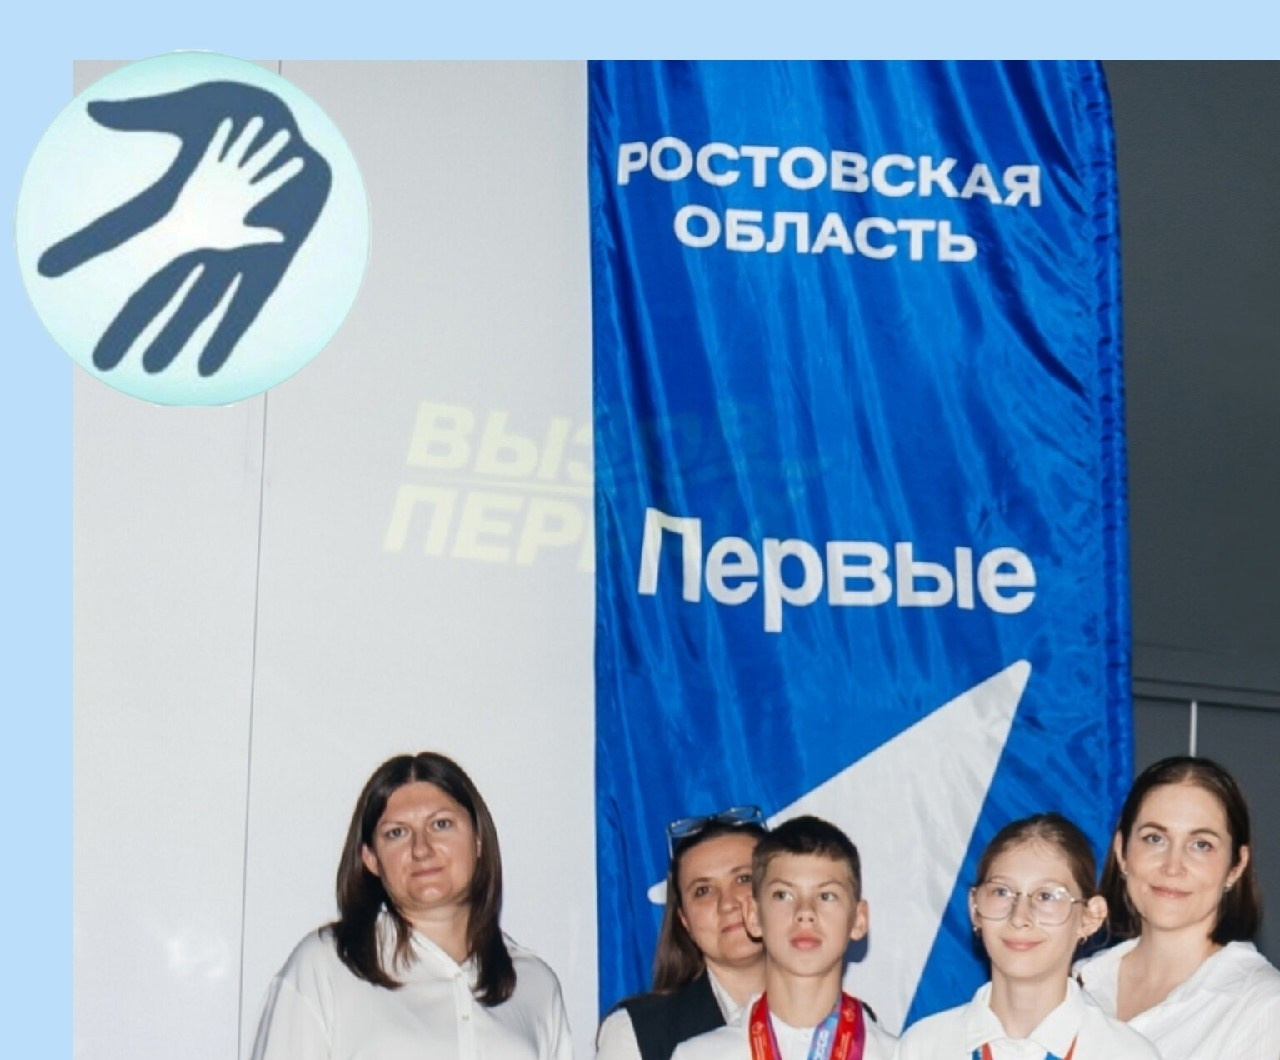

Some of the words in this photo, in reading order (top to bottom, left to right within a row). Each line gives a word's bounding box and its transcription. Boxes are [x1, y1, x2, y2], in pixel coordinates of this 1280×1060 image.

[617, 136, 1042, 208] РОСТОВСКАЯ
[673, 204, 978, 263] ОБЛАСТЬ
[638, 506, 1037, 633] Первые
